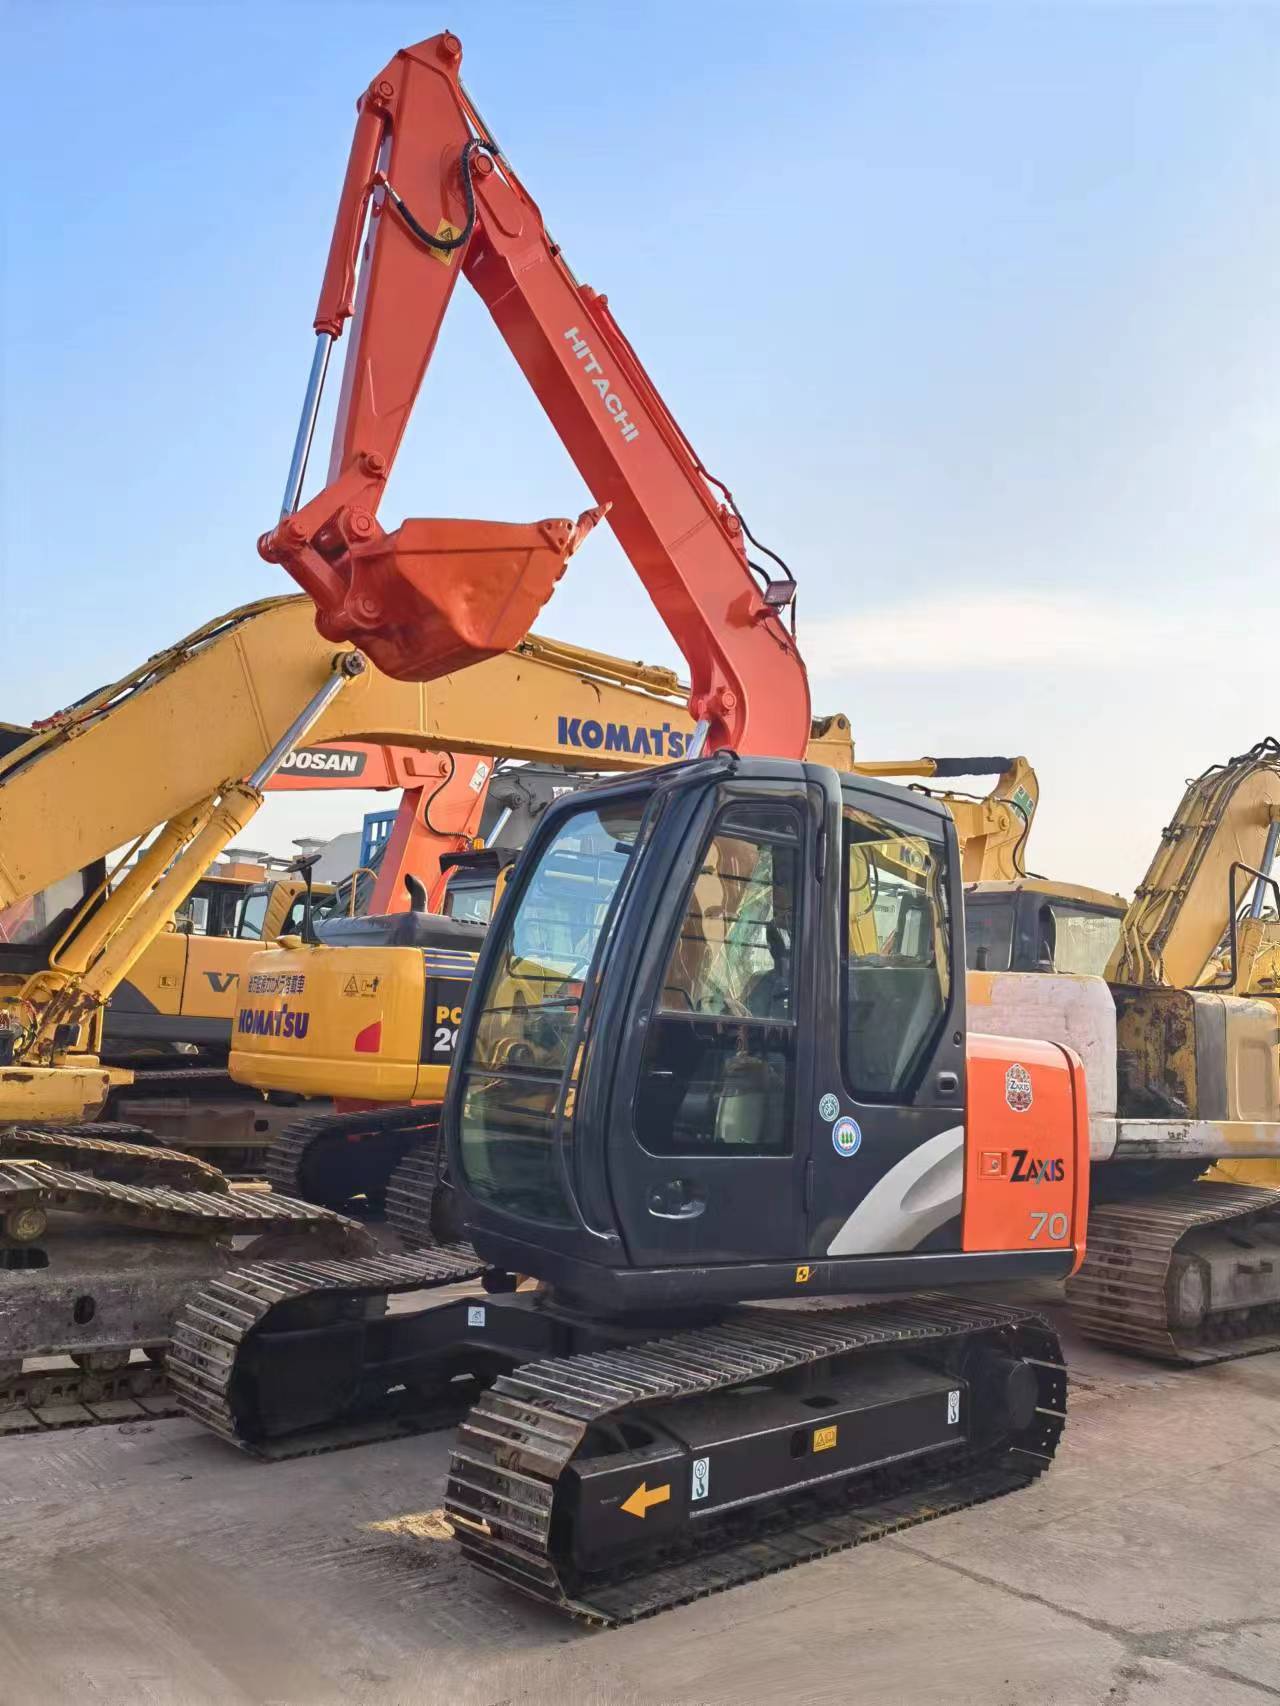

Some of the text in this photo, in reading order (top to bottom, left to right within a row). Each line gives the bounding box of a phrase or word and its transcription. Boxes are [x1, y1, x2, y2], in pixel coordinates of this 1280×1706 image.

[564, 327, 639, 442] HITACHI
[202, 971, 240, 992] V
[238, 1004, 310, 1039] KOMATSU
[1028, 1212, 1068, 1240] 70
